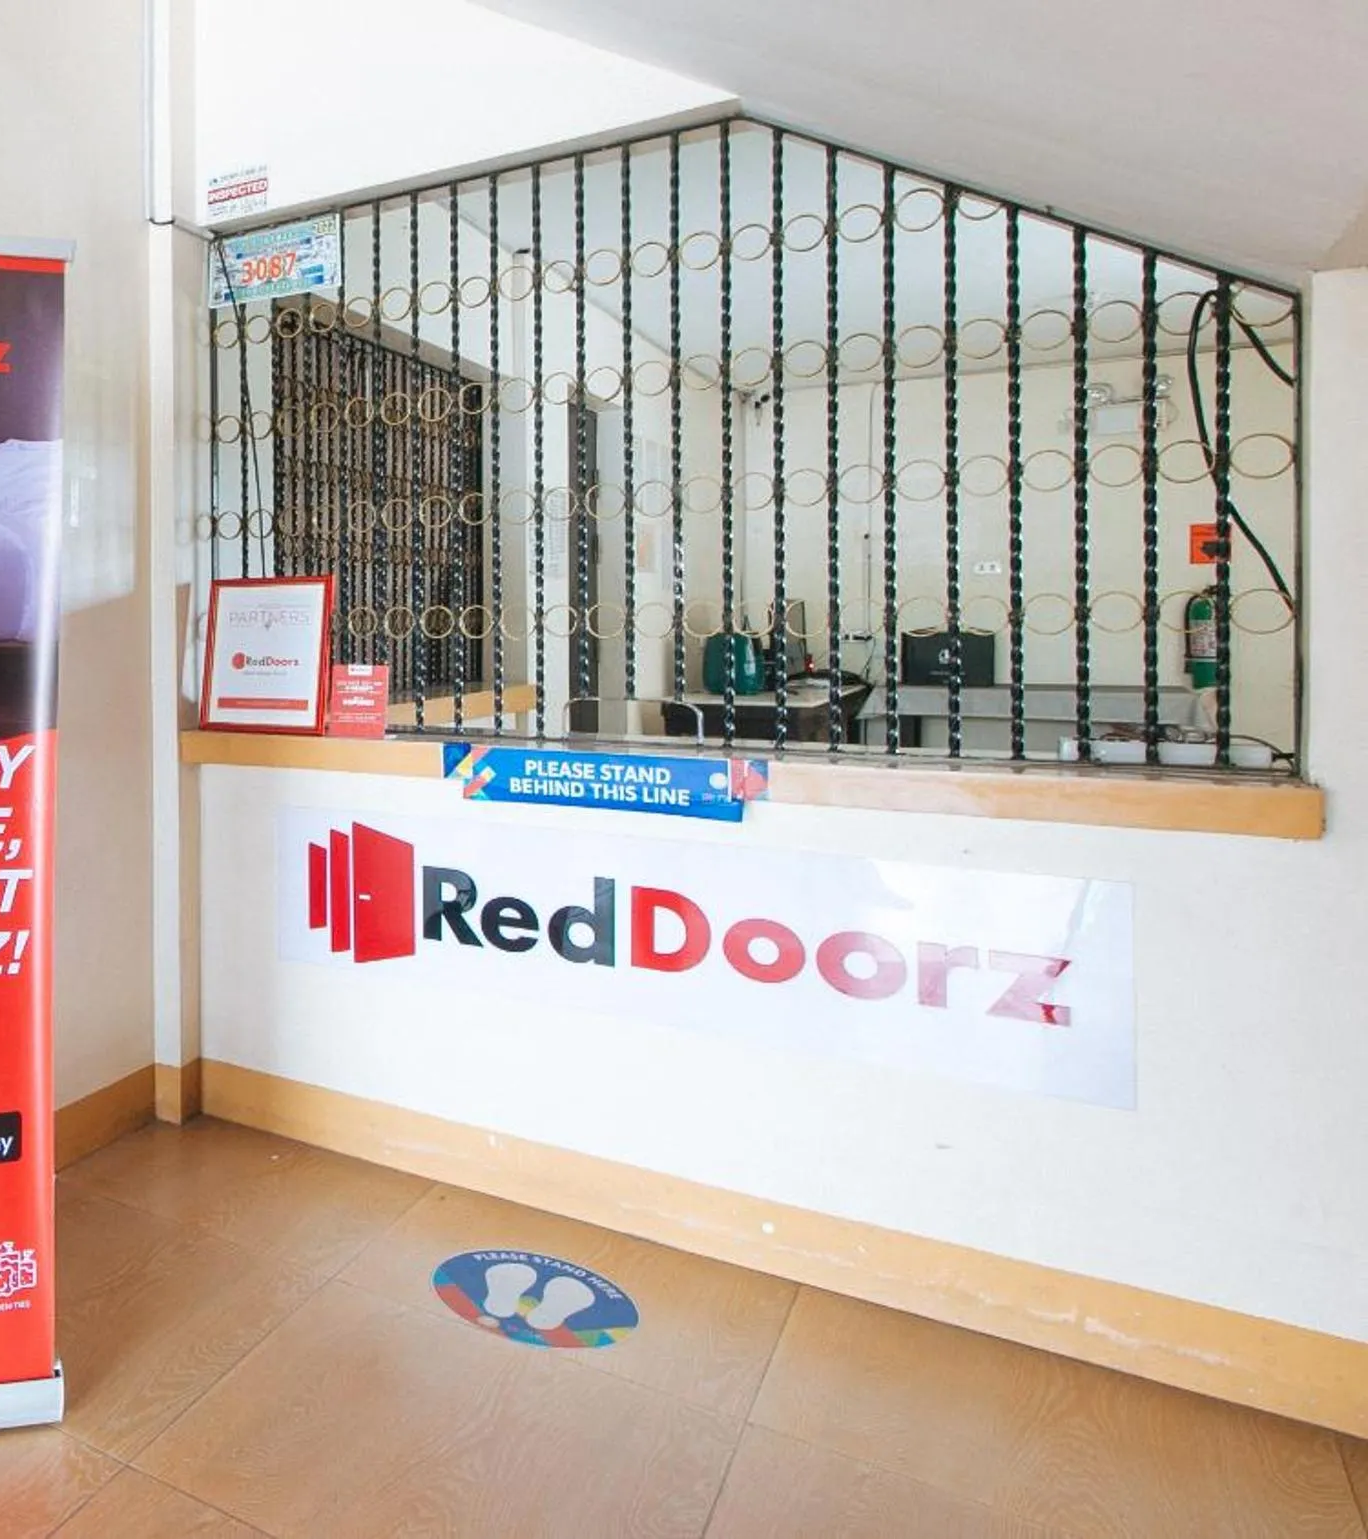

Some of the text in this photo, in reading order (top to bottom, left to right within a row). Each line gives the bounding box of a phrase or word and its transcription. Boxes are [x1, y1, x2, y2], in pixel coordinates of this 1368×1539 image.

[239, 250, 297, 285] 3087
[525, 759, 671, 785] PLEASE STAND
[510, 778, 584, 798] BEHIND
[590, 783, 638, 802] THIS
[642, 787, 691, 806] LINE
[422, 865, 1072, 1027] RedDoorz
[473, 1252, 623, 1301] PLEASE STAND HERE
